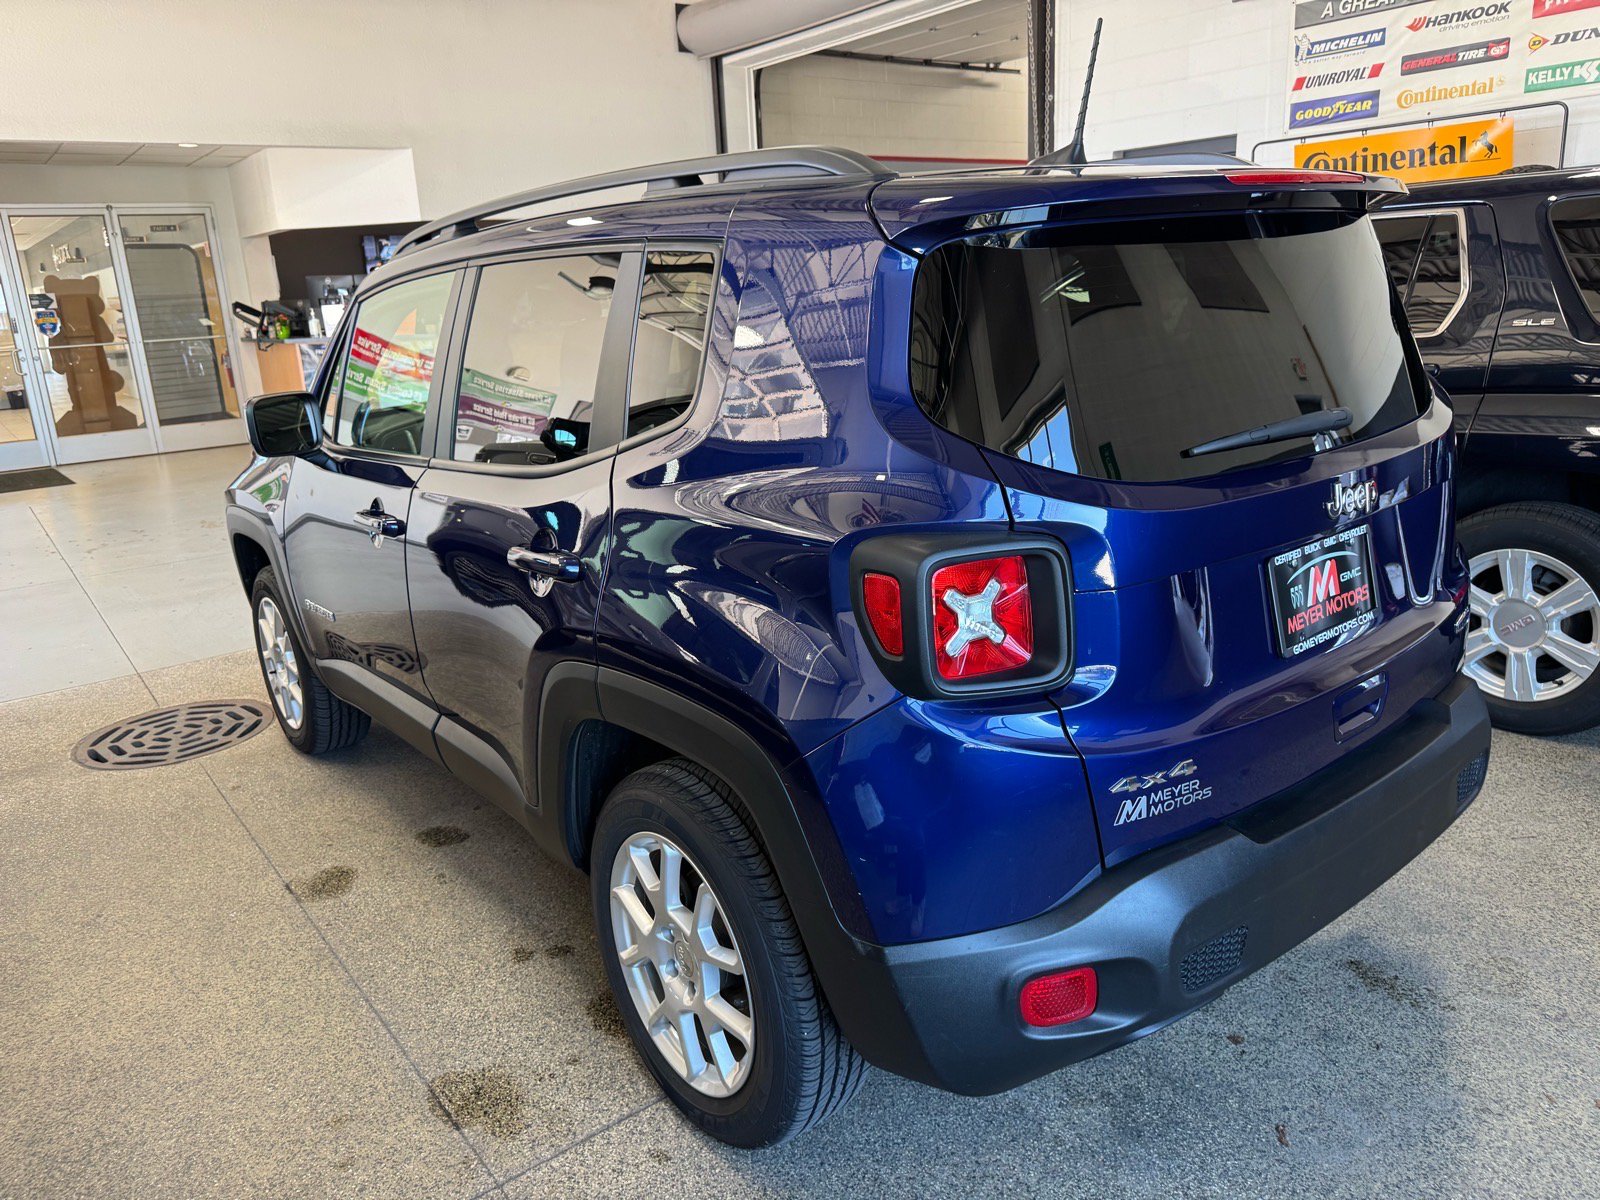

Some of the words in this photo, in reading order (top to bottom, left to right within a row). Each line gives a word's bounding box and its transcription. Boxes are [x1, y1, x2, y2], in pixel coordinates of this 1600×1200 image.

[1320, 1, 1334, 19] A
[1439, 22, 1469, 32] driving
[1470, 15, 1510, 26] emotion
[1311, 31, 1384, 54] MICHELIN
[1401, 53, 1457, 71] GENERAL
[1457, 48, 1487, 61] TIRE
[1305, 66, 1367, 89] UNIROYAL
[1527, 66, 1572, 86] KELLY
[1397, 77, 1495, 109] Continental
[1295, 100, 1373, 120] GOODYEAR
[1302, 135, 1469, 174] Continental
[1512, 317, 1556, 327] SLE
[1326, 480, 1379, 519] Jeep
[1274, 549, 1302, 566] CERTIFIED
[1304, 542, 1322, 555] BUICK
[1323, 536, 1337, 548] GMC
[1339, 524, 1367, 542] CHEVROLET
[1340, 566, 1362, 582] GMC
[1287, 605, 1324, 635] MEYER
[1325, 583, 1370, 616] MOTORS
[1293, 611, 1375, 655] GOMEYERMOTORS.COM
[1149, 779, 1200, 805] MEYER
[1149, 786, 1213, 818] MOTORS
